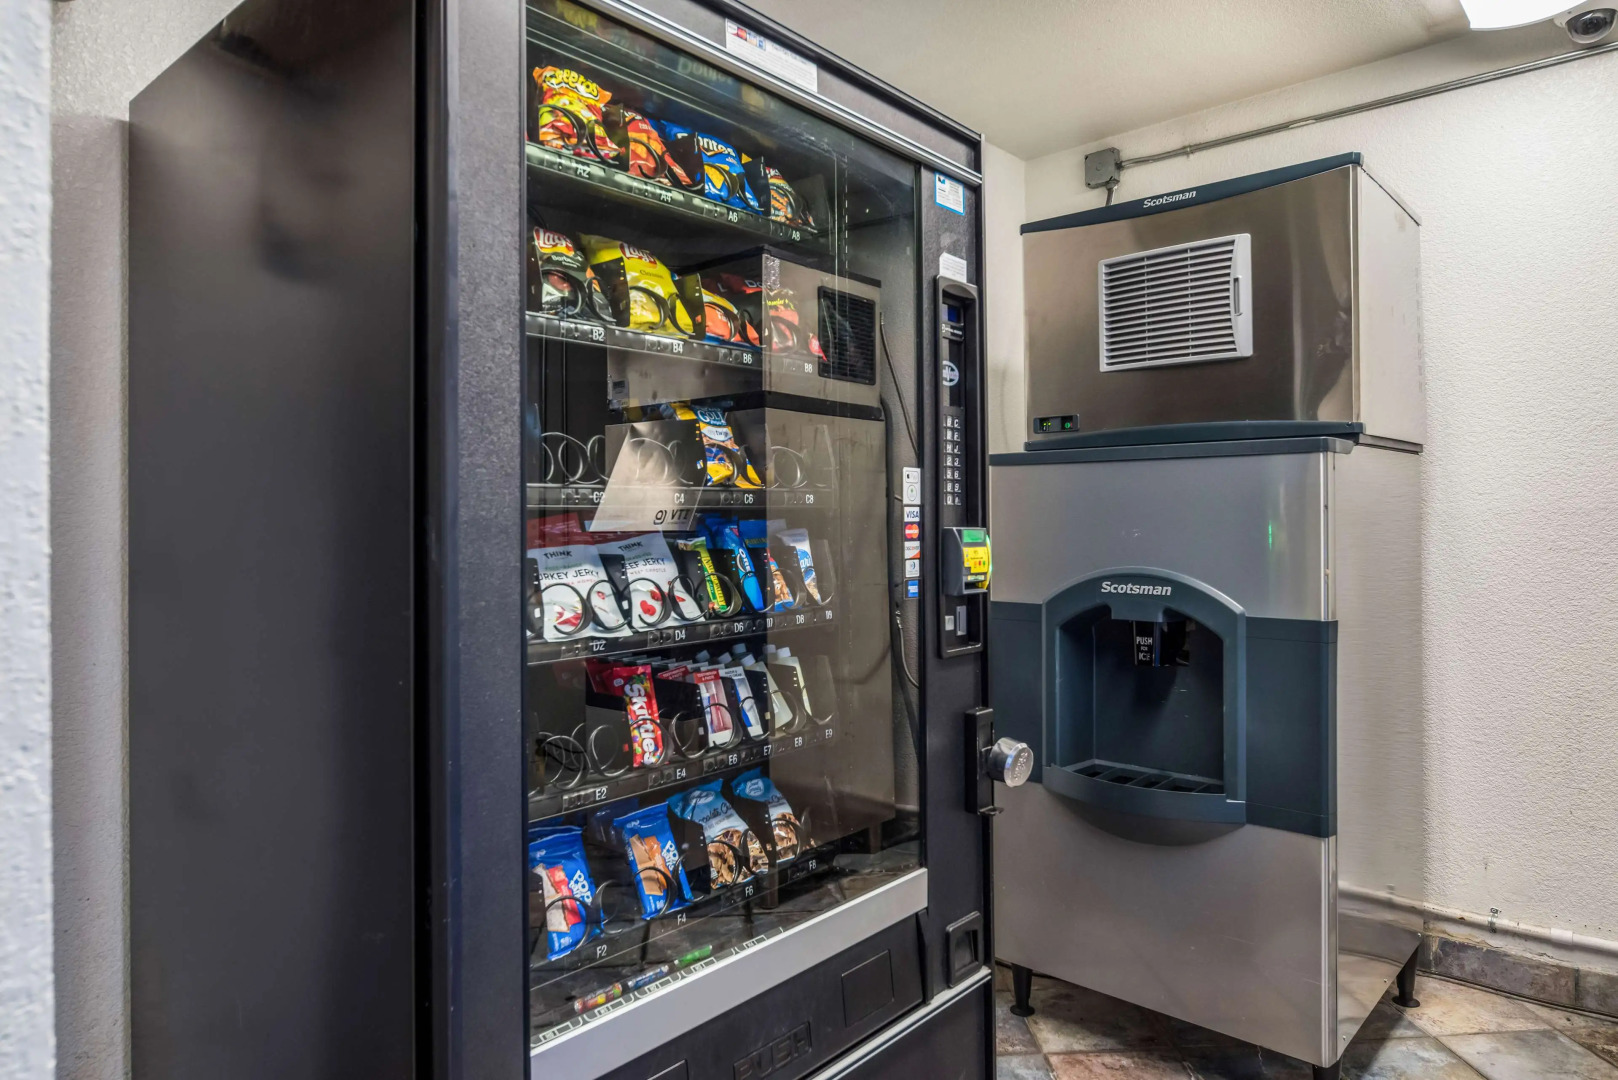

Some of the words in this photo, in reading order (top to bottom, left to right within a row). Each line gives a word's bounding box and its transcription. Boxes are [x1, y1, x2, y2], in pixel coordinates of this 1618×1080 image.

[1143, 190, 1197, 208] Scotsman
[728, 211, 738, 223] A6
[792, 231, 801, 241] A8
[593, 329, 605, 341] B2
[673, 342, 683, 353] B4
[743, 353, 752, 364] B6
[804, 363, 813, 373] B8
[593, 492, 605, 503] C2
[674, 493, 685, 504] C4
[744, 493, 754, 504] C6
[806, 494, 814, 504] C8
[906, 511, 919, 519] VISA
[618, 541, 643, 552] THINK
[543, 550, 573, 559] THINK
[624, 561, 640, 570] EEF
[640, 557, 665, 568] JERKY
[539, 571, 568, 581] URKEY
[572, 568, 599, 578] JERKY
[1101, 581, 1172, 596] Scotsman
[796, 614, 805, 624] D8
[734, 623, 744, 633] D6
[675, 630, 686, 640] D4
[1136, 636, 1153, 645] PUSH
[592, 640, 606, 651] D2
[1139, 652, 1151, 661] ICE
[825, 728, 833, 738] E9
[794, 737, 803, 747] E8
[764, 745, 772, 756] E7
[728, 754, 738, 765] E6
[676, 768, 687, 780] E4
[596, 787, 607, 800] E2
[808, 859, 817, 870] F8
[745, 885, 754, 897] F6
[677, 913, 687, 926] F4
[596, 944, 607, 958] F2
